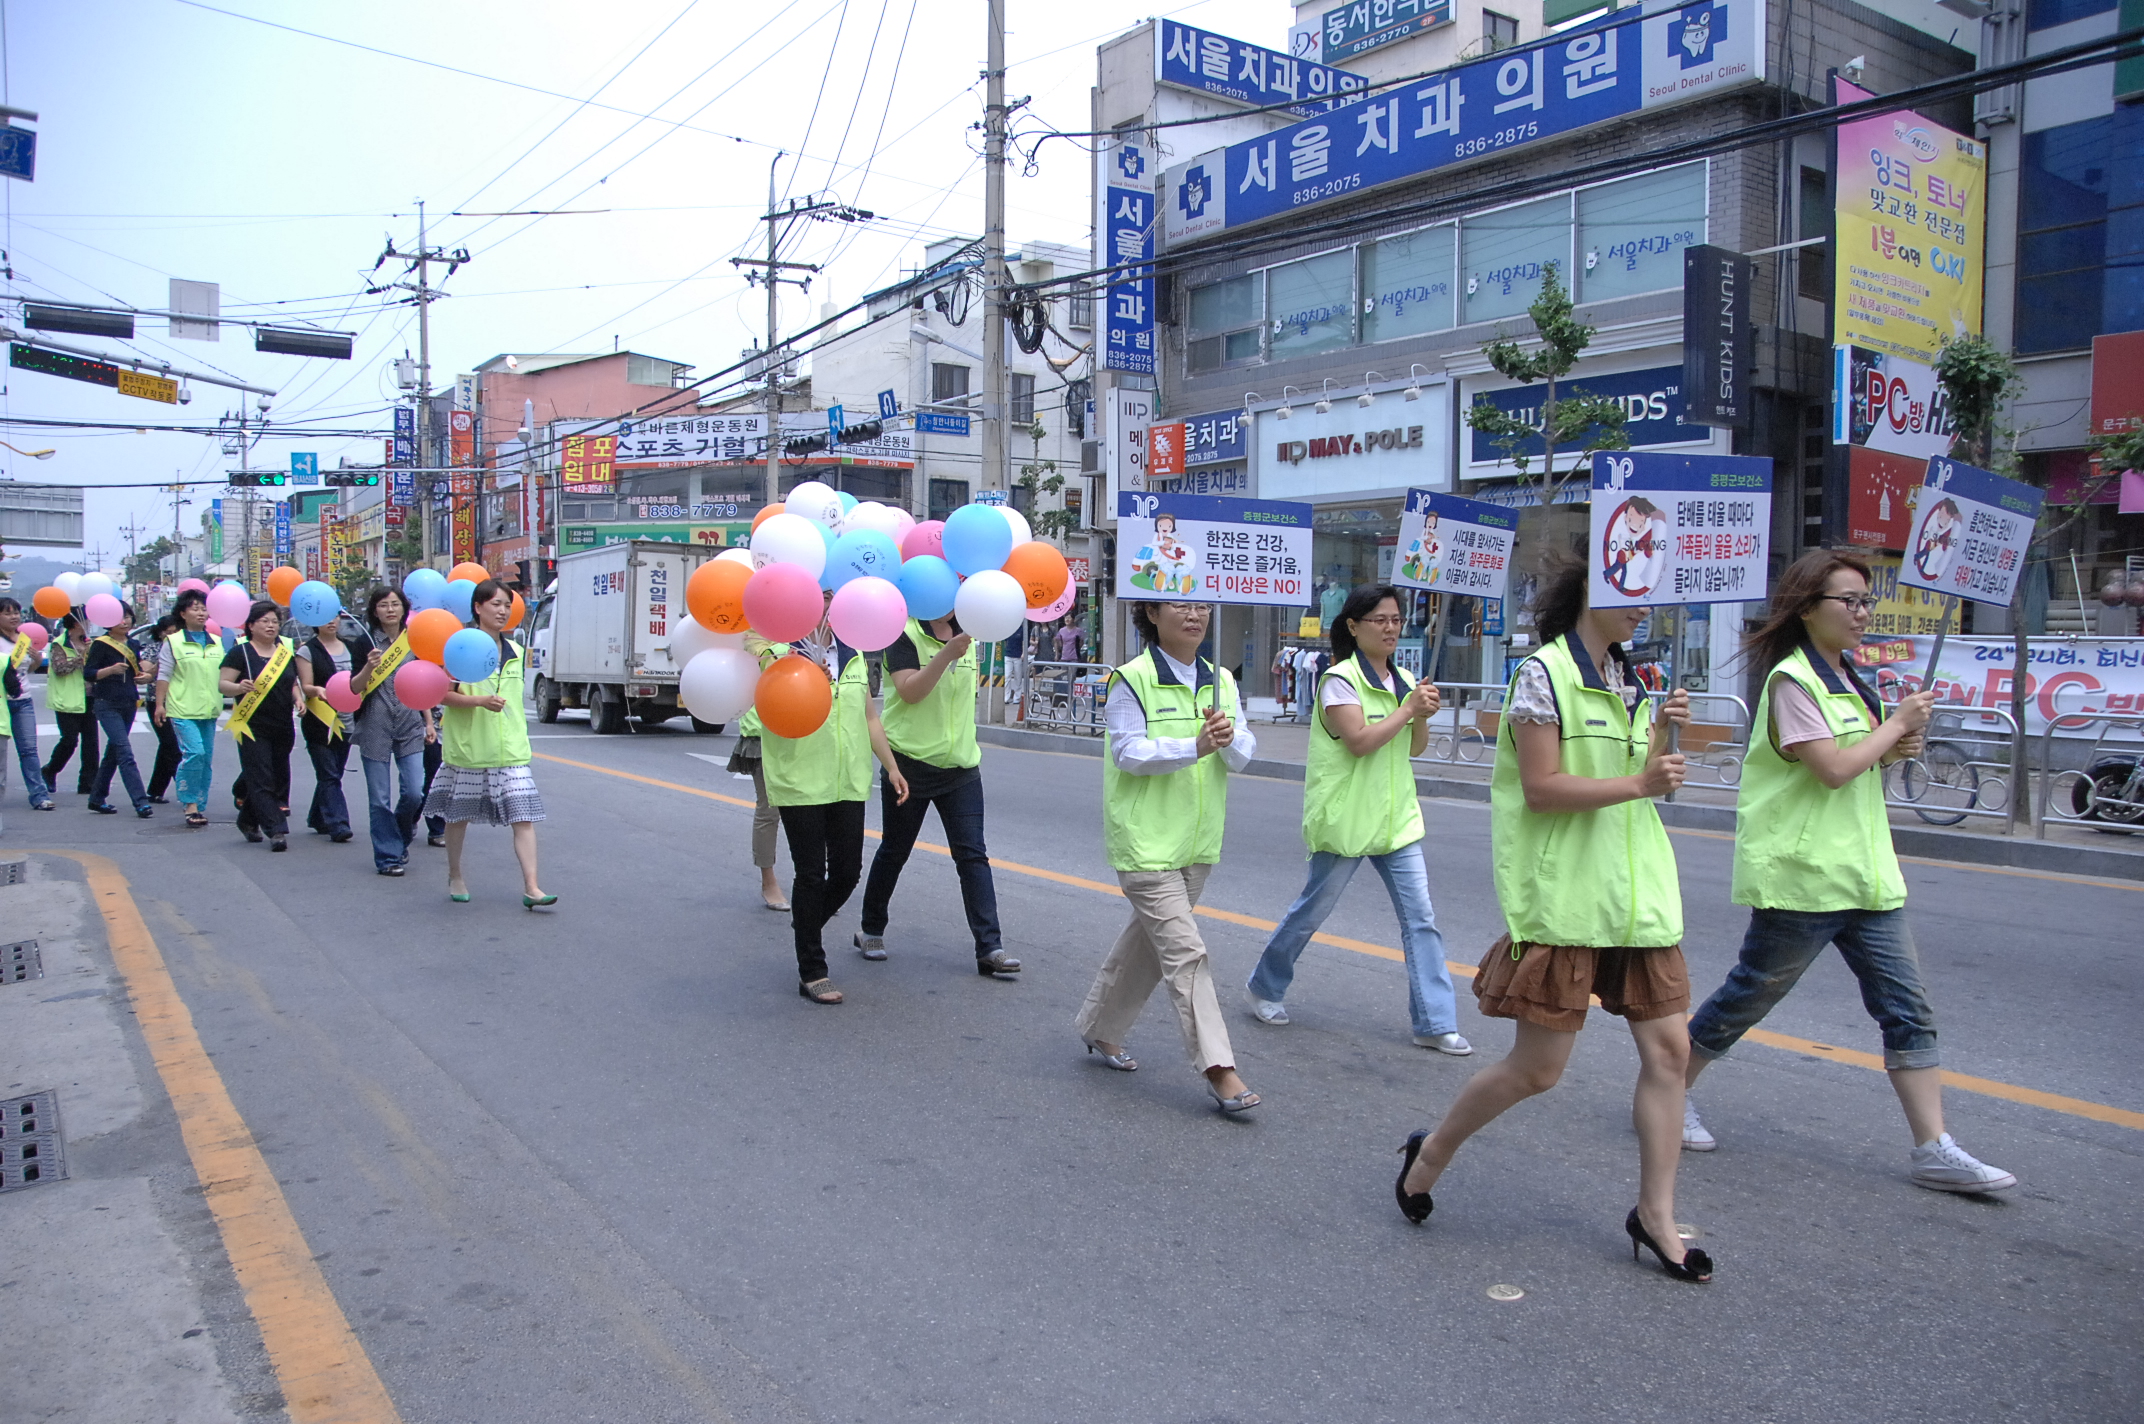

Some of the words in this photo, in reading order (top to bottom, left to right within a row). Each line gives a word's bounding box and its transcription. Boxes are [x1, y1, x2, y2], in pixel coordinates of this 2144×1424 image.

[1649, 82, 1676, 98] Seoul
[1681, 71, 1714, 90] Dental
[1718, 62, 1747, 79] Clinic
[1293, 173, 1361, 204] 836-2075
[1455, 121, 1538, 158] 836-2875
[1870, 148, 1918, 200] 잉크,
[1927, 174, 1966, 217] 토너
[1168, 226, 1185, 240] Seoul
[1205, 217, 1221, 230] Clinic
[1870, 188, 1918, 226] 맞교환
[1924, 210, 1966, 246] 전문점
[1720, 257, 1734, 334] HUNT
[1110, 328, 1150, 350] 의원
[1108, 350, 1152, 364] 836-2075
[1108, 358, 1152, 373] 836-2875
[1720, 339, 1733, 400] KIDS
[122, 383, 149, 397] CCTV
[1866, 367, 1925, 434] PC방
[2103, 417, 2127, 431] 문구
[615, 437, 686, 458] 스포츠
[1129, 430, 1143, 470] 메이
[1309, 434, 1355, 459] MAY
[1353, 441, 1362, 454] &
[1364, 425, 1424, 452] POLE
[564, 460, 611, 482] 임대
[1131, 474, 1142, 486] &
[1710, 473, 1763, 488] 증평군보건소
[1243, 511, 1298, 524] 증평군보건소
[1677, 500, 1705, 528] 담배를
[1707, 500, 1725, 527] 태울
[1727, 501, 1754, 528] 때마다
[1969, 509, 1998, 538] 흡연하는
[1206, 530, 1250, 551] 한잔은
[1255, 534, 1288, 554] 건강,
[1452, 529, 1477, 548] 시대를
[1477, 533, 1506, 553] 앞서가는
[1675, 533, 1712, 560] 가족들의
[1714, 533, 1732, 560] 울음
[1734, 533, 1761, 560] 소리가
[1205, 551, 1250, 572] 두잔은
[1254, 555, 1302, 576] 즐거움,
[1449, 548, 1467, 566] 지성,
[1468, 551, 1505, 571] 절주문화로
[1962, 538, 1979, 561] 지금
[1976, 542, 1999, 567] 당신의
[1997, 547, 2019, 572] 생명을
[1068, 559, 1088, 582] 泰
[1445, 568, 1468, 586] 이끌어
[1469, 571, 1492, 589] 갑시다.
[1674, 566, 1702, 594] 들리지
[1704, 565, 1745, 593] 않습니까?
[1955, 565, 1983, 590] 태워가고
[1981, 571, 2010, 597] 있습니다.
[593, 570, 625, 596] 천일택배
[1205, 574, 1220, 592] 더
[1225, 575, 1269, 594] 이상은
[1274, 579, 1301, 595] NO!
[649, 569, 667, 636] 천일택배
[1860, 647, 1881, 665] 1월
[1885, 643, 1909, 662] 9일
